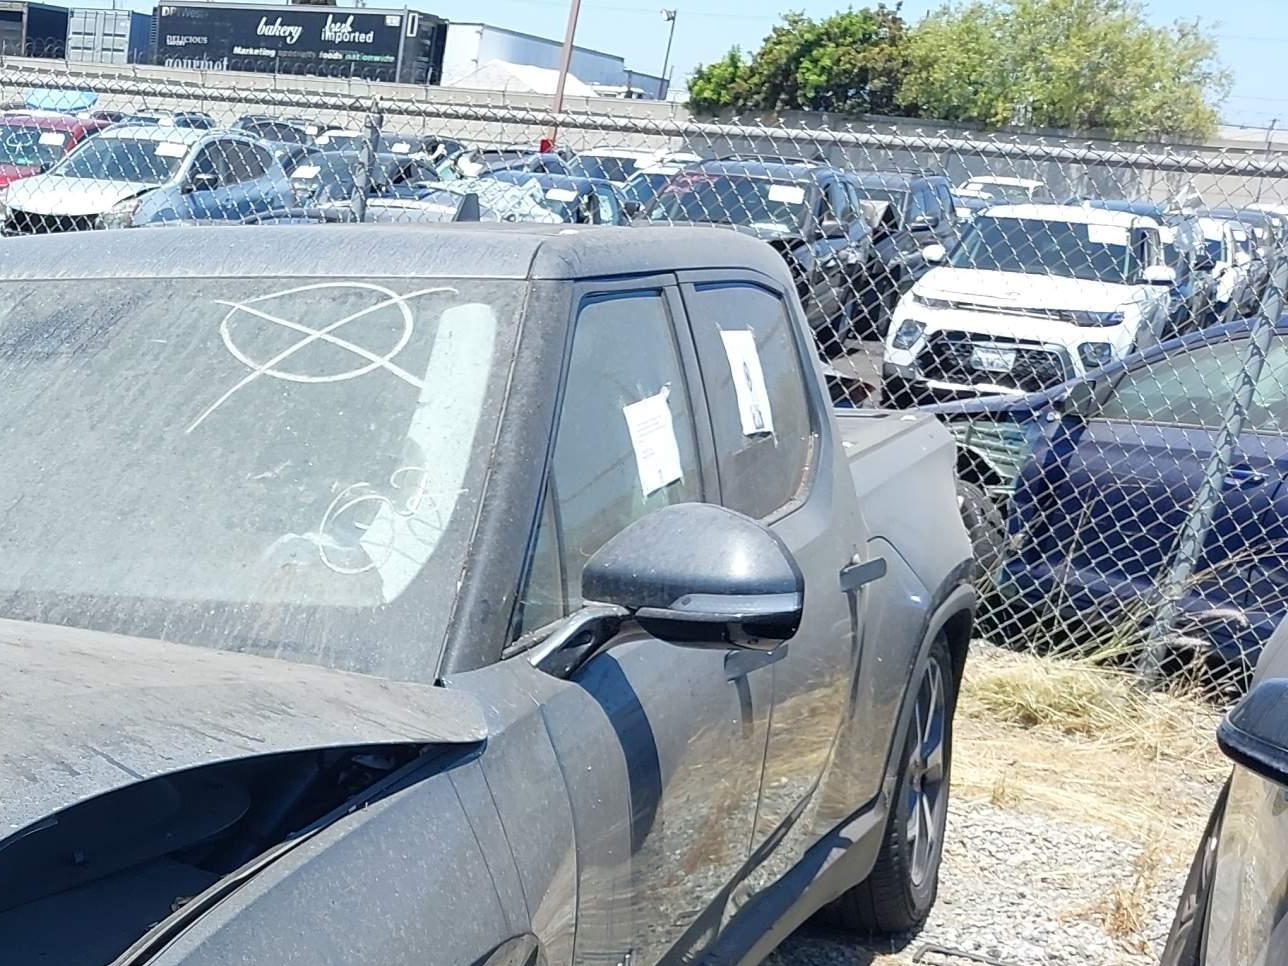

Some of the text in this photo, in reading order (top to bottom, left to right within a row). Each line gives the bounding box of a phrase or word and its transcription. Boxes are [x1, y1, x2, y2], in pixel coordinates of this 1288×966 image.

[256, 17, 303, 43] bakery
[321, 29, 374, 43] imported
[233, 46, 276, 57] Marketing
